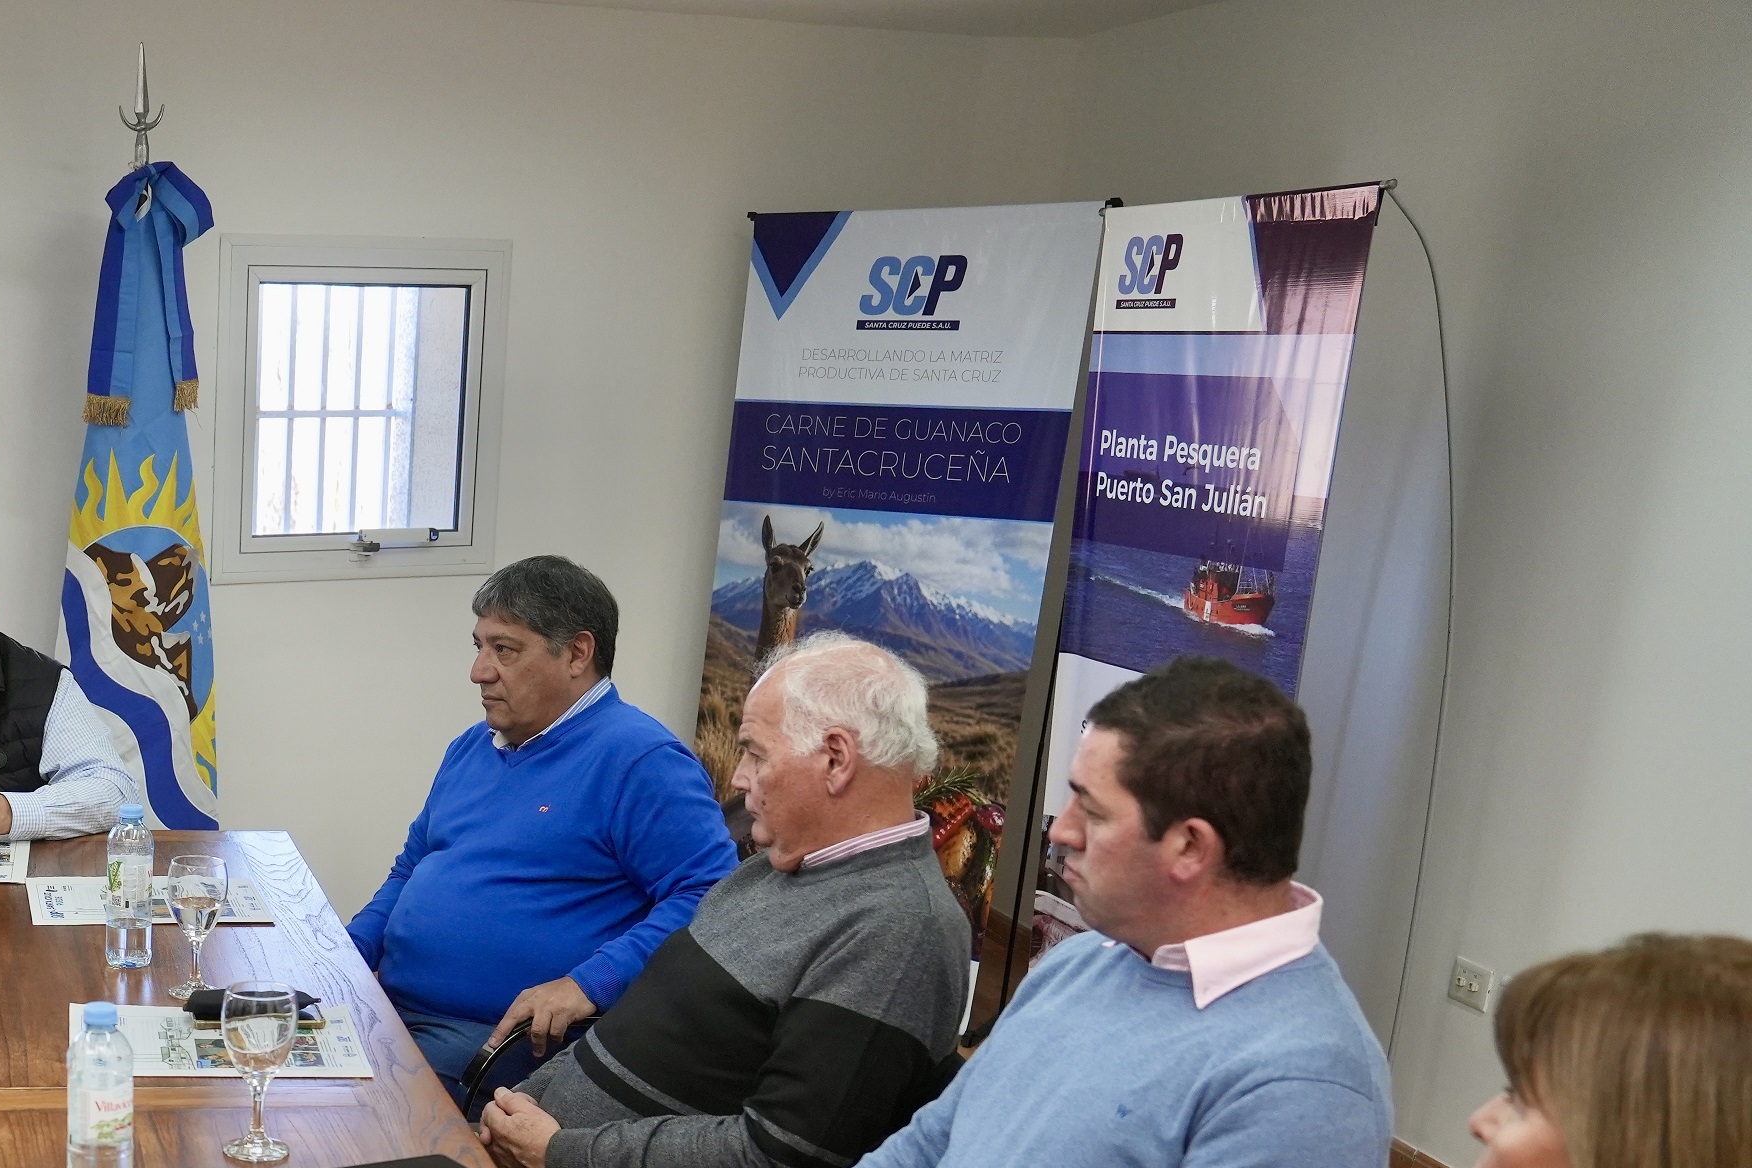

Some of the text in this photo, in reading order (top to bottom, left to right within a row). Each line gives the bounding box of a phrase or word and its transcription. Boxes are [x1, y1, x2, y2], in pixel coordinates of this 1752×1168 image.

[1118, 233, 1184, 295] SCP
[858, 254, 968, 316] SCP
[798, 366, 1002, 383] PRODUCTIVA DE SANTA CRUZ
[802, 348, 1004, 364] DESARROLLANDO LA MATRIZ
[765, 413, 1022, 445] CARNE DE GUANACO
[761, 445, 1010, 484] SANTACRUCEÑA
[1100, 429, 1261, 473] Planta Pesquera
[822, 486, 835, 498] by
[837, 487, 855, 499] Eric
[858, 489, 887, 501] Mario
[1096, 471, 1267, 518] Puerto San Julián
